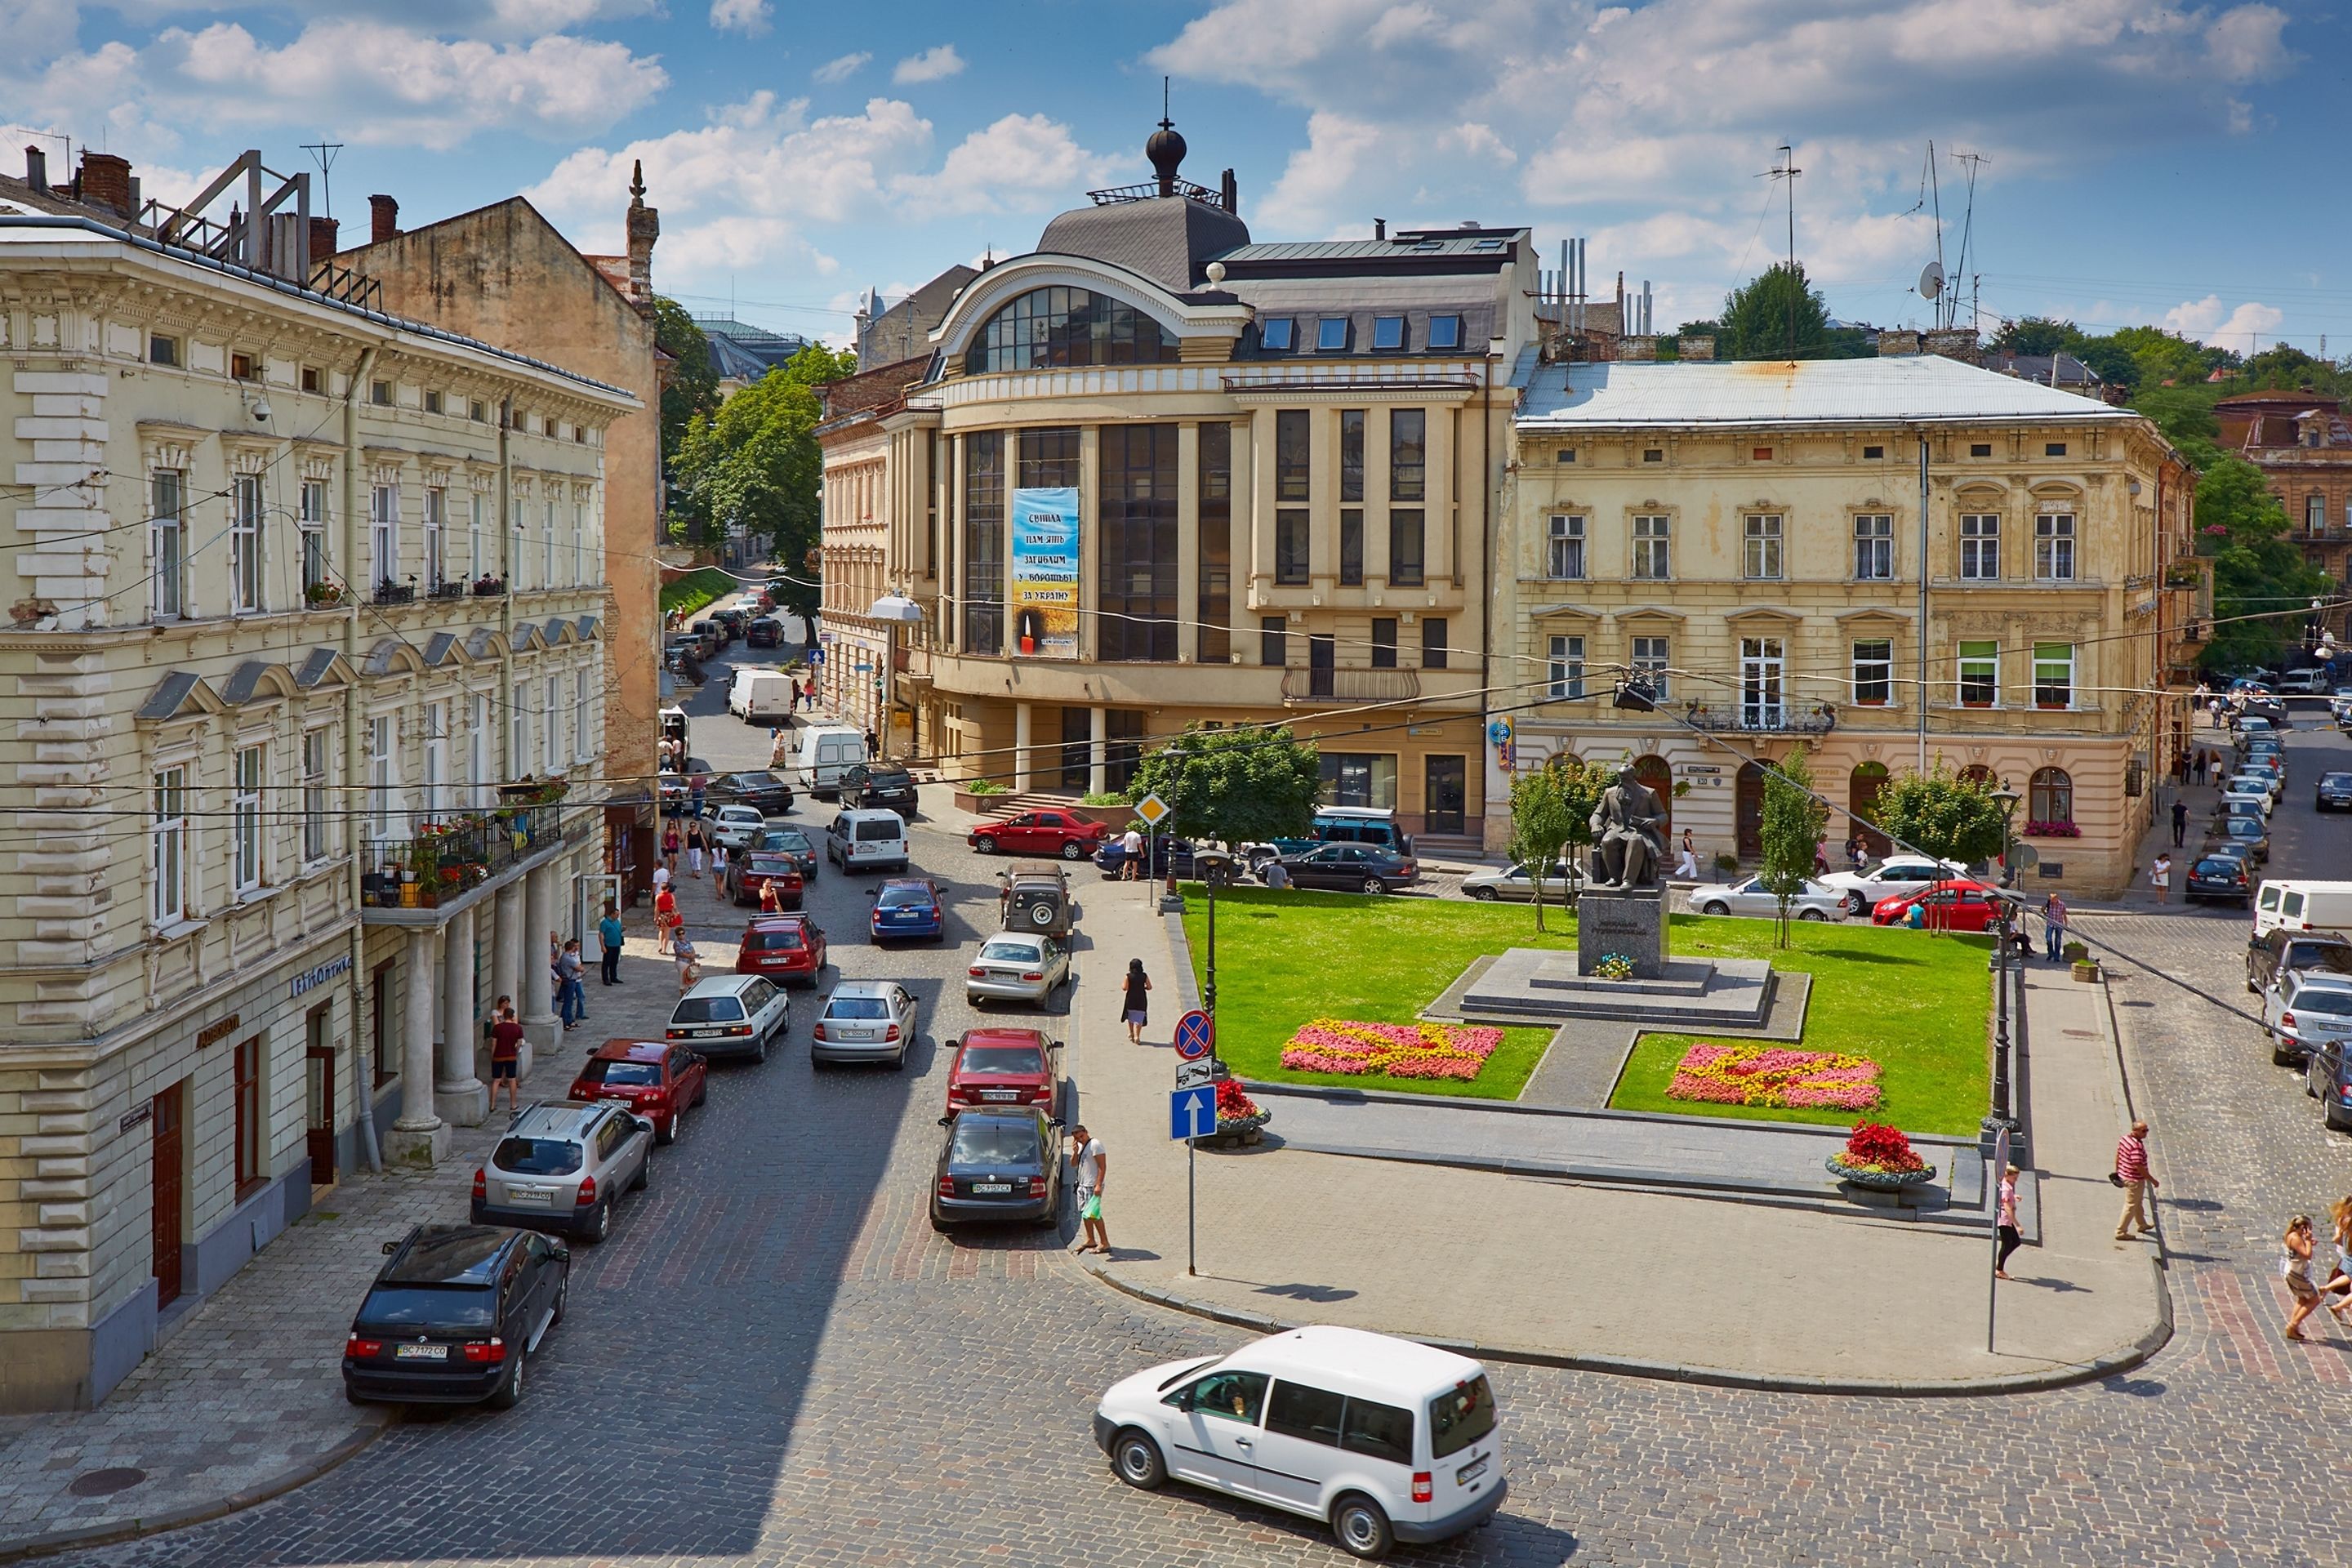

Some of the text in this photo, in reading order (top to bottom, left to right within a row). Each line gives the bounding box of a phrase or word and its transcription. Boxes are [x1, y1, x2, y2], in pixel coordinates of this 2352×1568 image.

[1025, 556, 1066, 564] ЗАГИБЛИМ
[1018, 574, 1023, 582] У
[1023, 591, 1069, 600] ЗА УКРАЇНУ
[403, 1346, 446, 1356] BC 7172 CO
